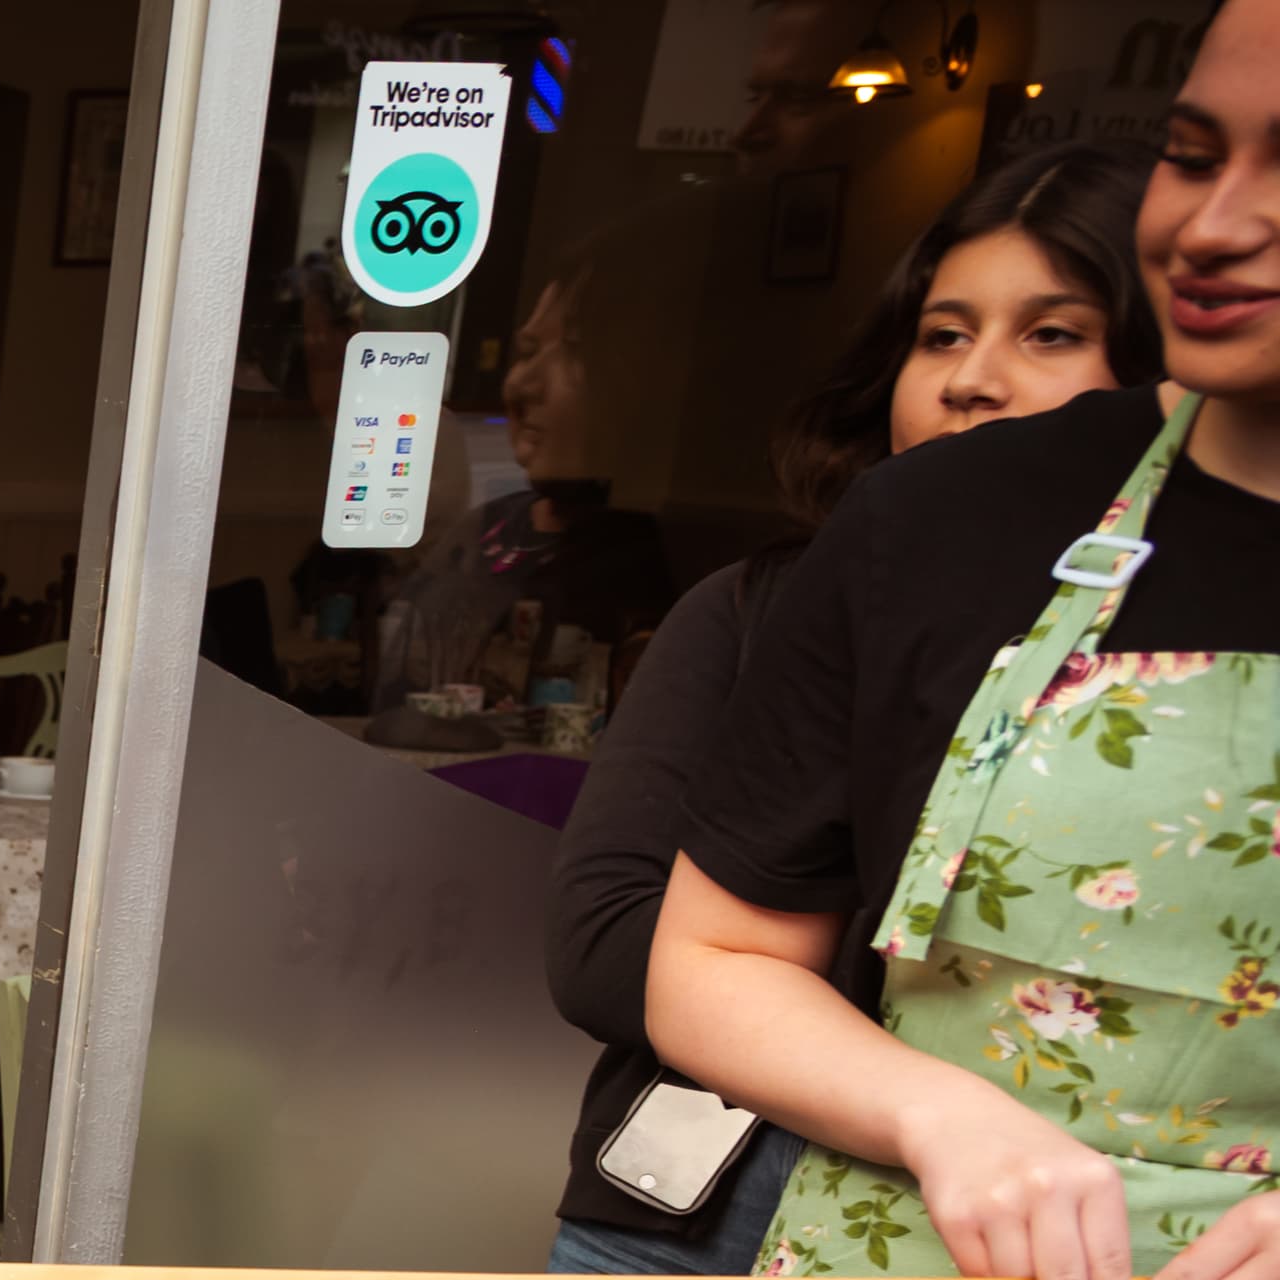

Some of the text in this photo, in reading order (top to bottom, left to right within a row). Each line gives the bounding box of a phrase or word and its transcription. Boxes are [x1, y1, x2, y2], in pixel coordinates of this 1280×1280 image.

[386, 81, 483, 103] We're on
[370, 104, 494, 131] Tripadvisor
[380, 352, 430, 367] PayPal
[354, 417, 379, 427] VISA
